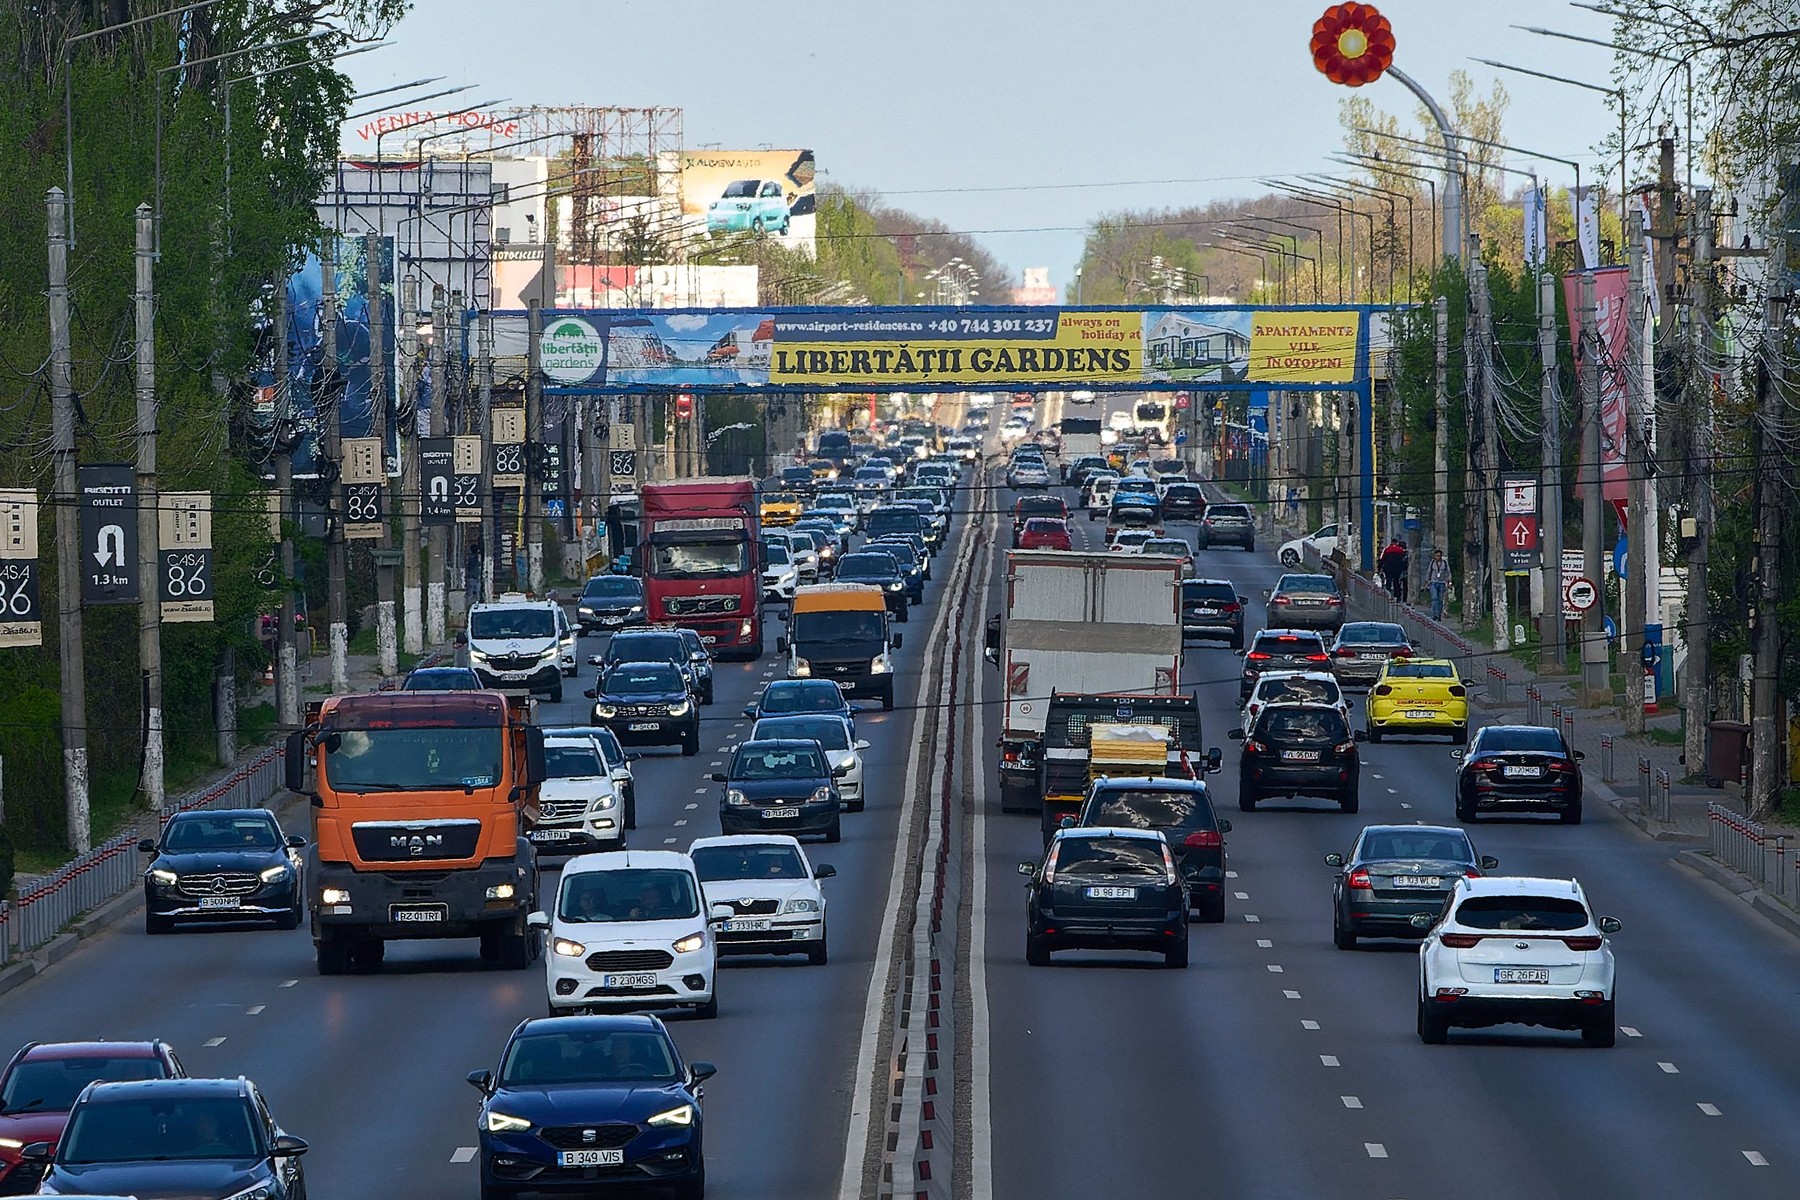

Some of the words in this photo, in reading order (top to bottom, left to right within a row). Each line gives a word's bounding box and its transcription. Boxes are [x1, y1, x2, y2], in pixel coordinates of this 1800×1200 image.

[357, 111, 437, 141] VIENNA
[448, 111, 518, 138] HOUSE
[776, 321, 923, 333] www.airport-residences.ro
[929, 319, 957, 332] +40
[961, 318, 989, 332] 744
[992, 318, 1021, 332] 301
[1024, 318, 1054, 332] 237
[1061, 318, 1102, 328] always
[1106, 319, 1120, 327] on
[1081, 329, 1125, 341] holiday
[1129, 331, 1141, 340] at
[1256, 325, 1353, 337] APARTAMENTE
[1289, 342, 1319, 352] VILE
[546, 356, 595, 372] gardens
[777, 343, 959, 379] LIBERTĂȚII
[971, 348, 1130, 373] GARDENS
[1284, 357, 1342, 368] OTOPENI
[496, 452, 521, 472] 86
[613, 457, 633, 474] 86
[348, 486, 378, 496] CASA
[348, 496, 378, 520] 86
[167, 554, 205, 567] CASA
[92, 575, 110, 585] 1.3
[113, 575, 128, 585] km
[167, 565, 206, 596] 86
[390, 835, 442, 847] MAN
[1398, 876, 1404, 884] B
[1093, 888, 1100, 897] B
[610, 976, 617, 986] B
[1501, 970, 1514, 980] GR
[566, 1153, 574, 1164] B
[578, 1152, 598, 1164] 349
[602, 1151, 620, 1162] VIS
